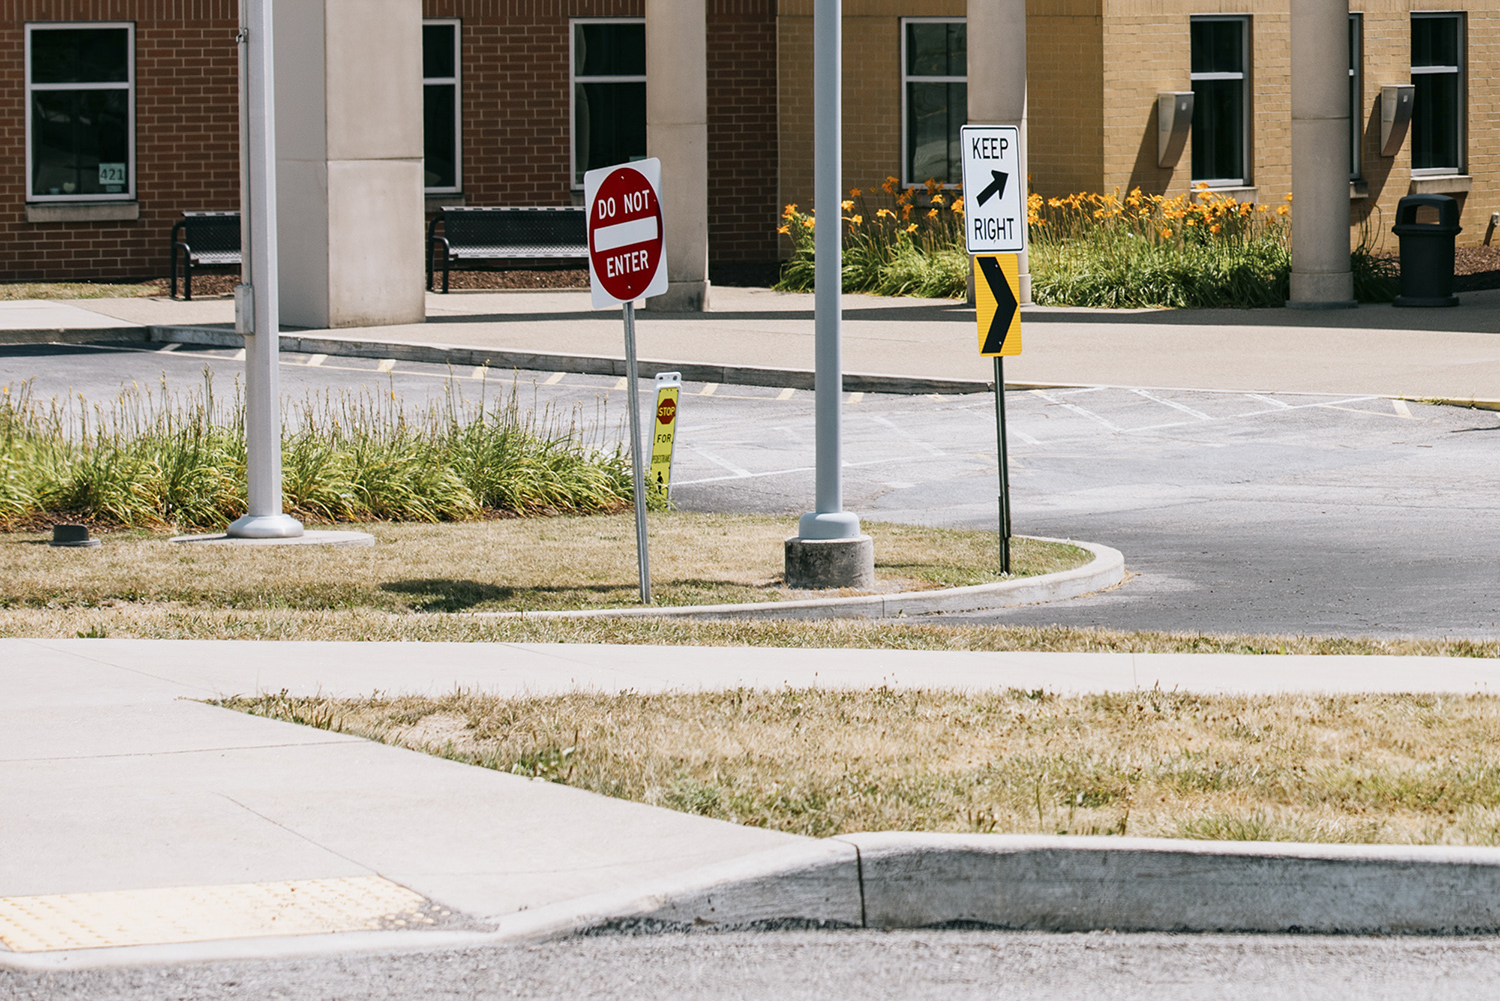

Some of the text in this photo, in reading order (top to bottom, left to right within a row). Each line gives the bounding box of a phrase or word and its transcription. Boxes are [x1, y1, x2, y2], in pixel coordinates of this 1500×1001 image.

[971, 137, 1009, 159] KEEP
[100, 168, 124, 181] 421
[598, 189, 650, 220] DO NOT
[973, 217, 1014, 240] RIGHT
[606, 249, 649, 278] ENTER
[658, 406, 676, 417] STOP
[656, 433, 672, 443] FOR
